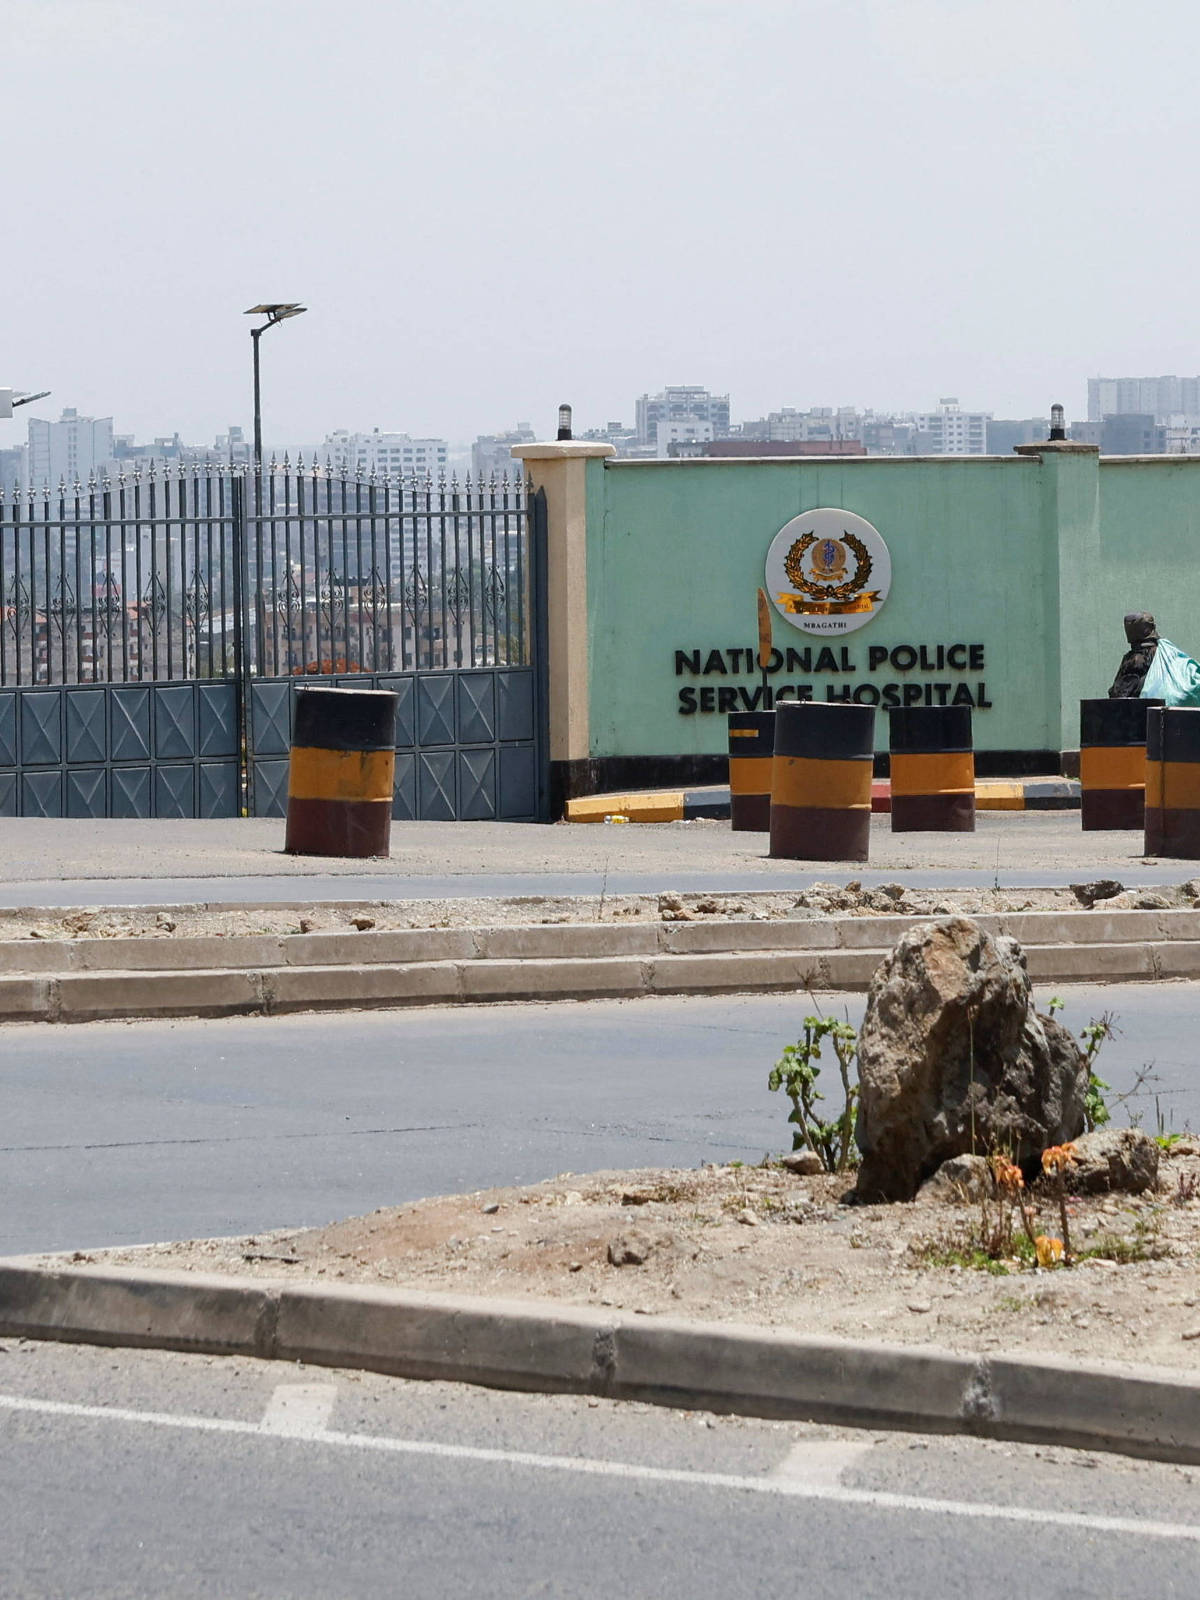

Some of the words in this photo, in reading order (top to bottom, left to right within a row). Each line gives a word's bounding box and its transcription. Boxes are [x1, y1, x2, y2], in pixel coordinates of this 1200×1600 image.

[803, 621, 847, 629] MBAGATHI
[675, 646, 856, 675] NATIONAL
[868, 644, 985, 671] POLICE
[826, 682, 993, 711] HOSPITAL
